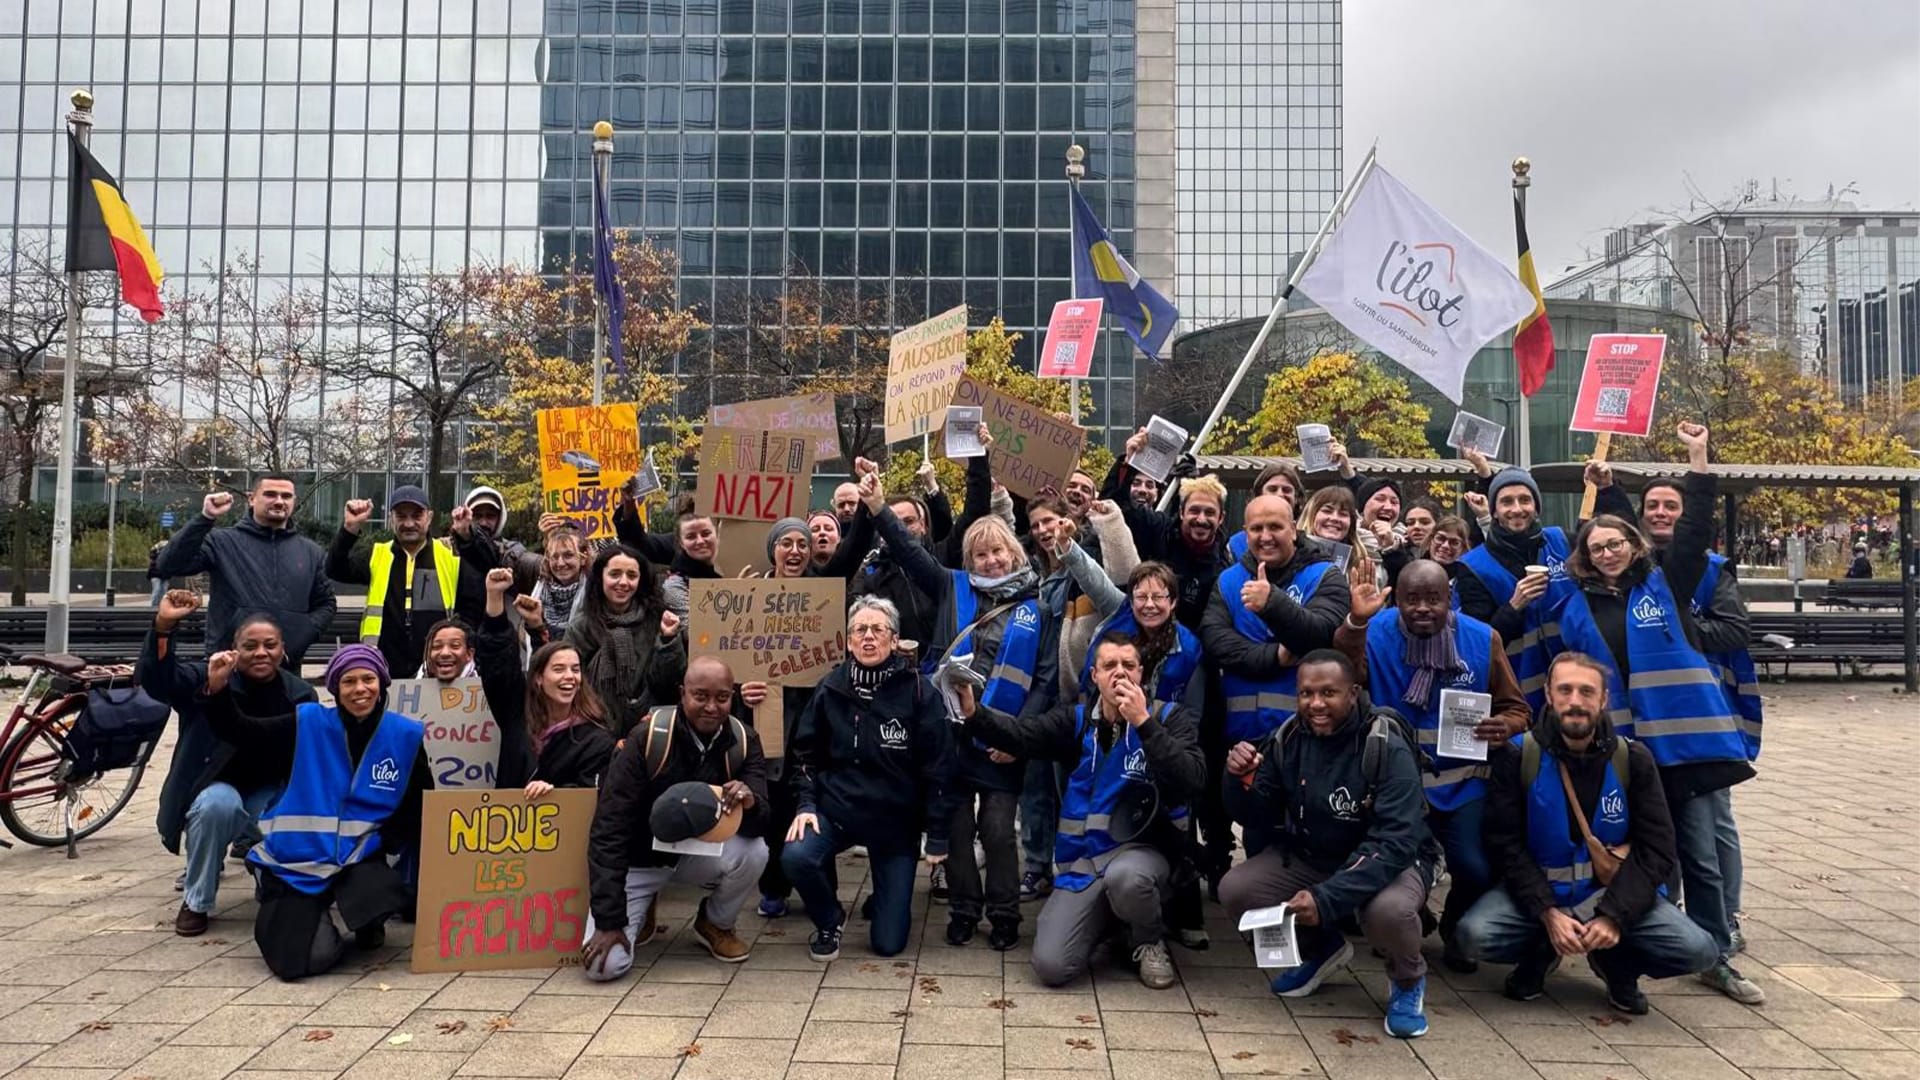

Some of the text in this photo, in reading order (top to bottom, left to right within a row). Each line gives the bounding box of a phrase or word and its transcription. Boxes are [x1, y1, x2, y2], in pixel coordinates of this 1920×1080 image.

[1352, 296, 1377, 319] SORTIR
[1376, 313, 1389, 325] DU
[1610, 343, 1638, 354] STOP
[890, 381, 904, 398] ON
[950, 361, 965, 376] PAR
[887, 382, 954, 427] LA SOLIDAR
[958, 380, 988, 406] ON
[993, 397, 1018, 422] NE
[546, 407, 613, 434] LE PRIX
[990, 421, 1026, 454] PAS
[732, 617, 753, 633] LA
[753, 650, 773, 666] LA
[474, 858, 528, 894] LES
[438, 887, 581, 959] FACHOS
